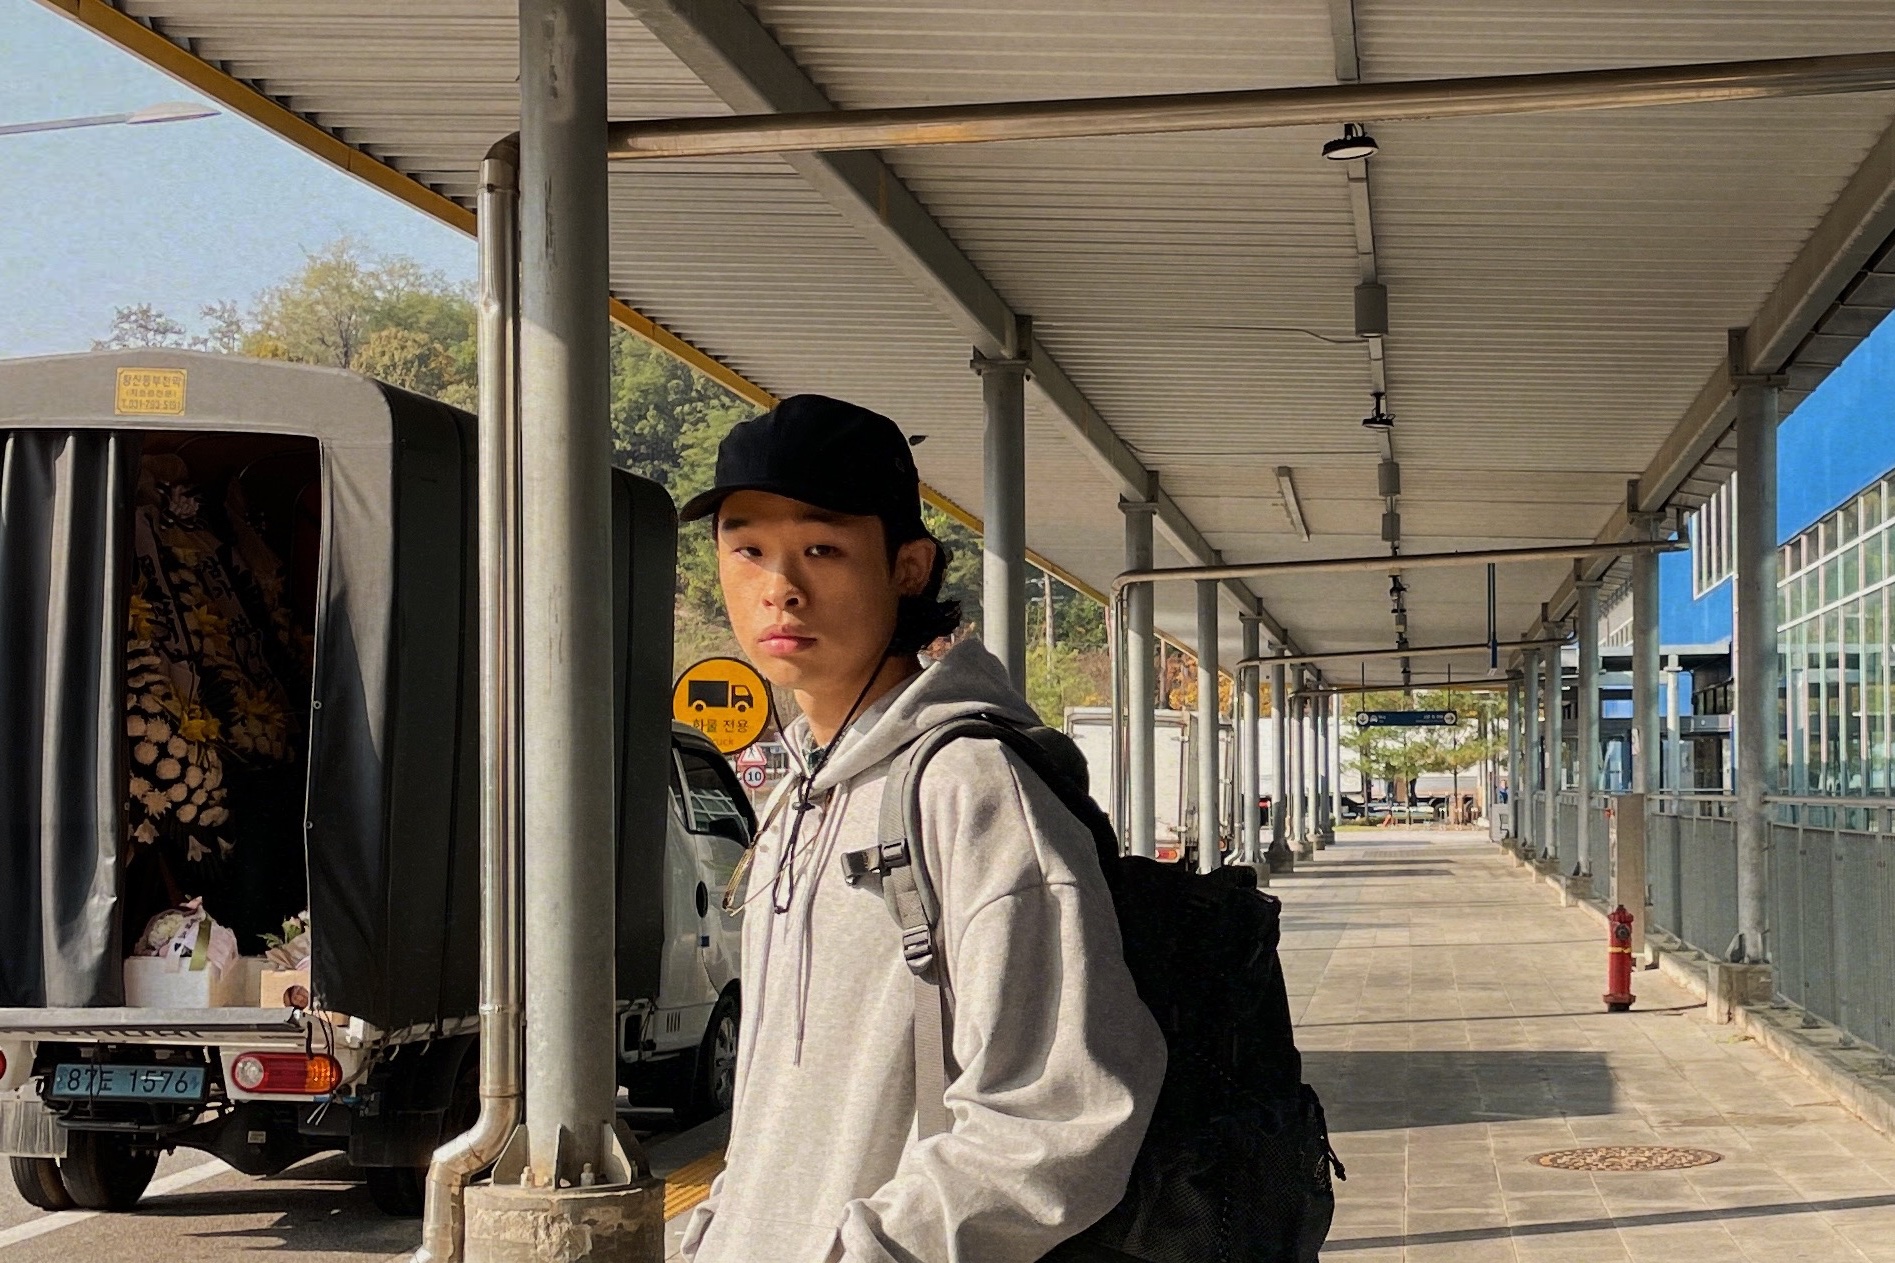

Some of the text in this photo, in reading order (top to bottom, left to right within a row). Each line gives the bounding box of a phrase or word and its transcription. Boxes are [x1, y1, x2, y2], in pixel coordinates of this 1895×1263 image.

[723, 718, 748, 733] 전용
[748, 771, 762, 782] 10
[129, 1069, 188, 1094] 1576
